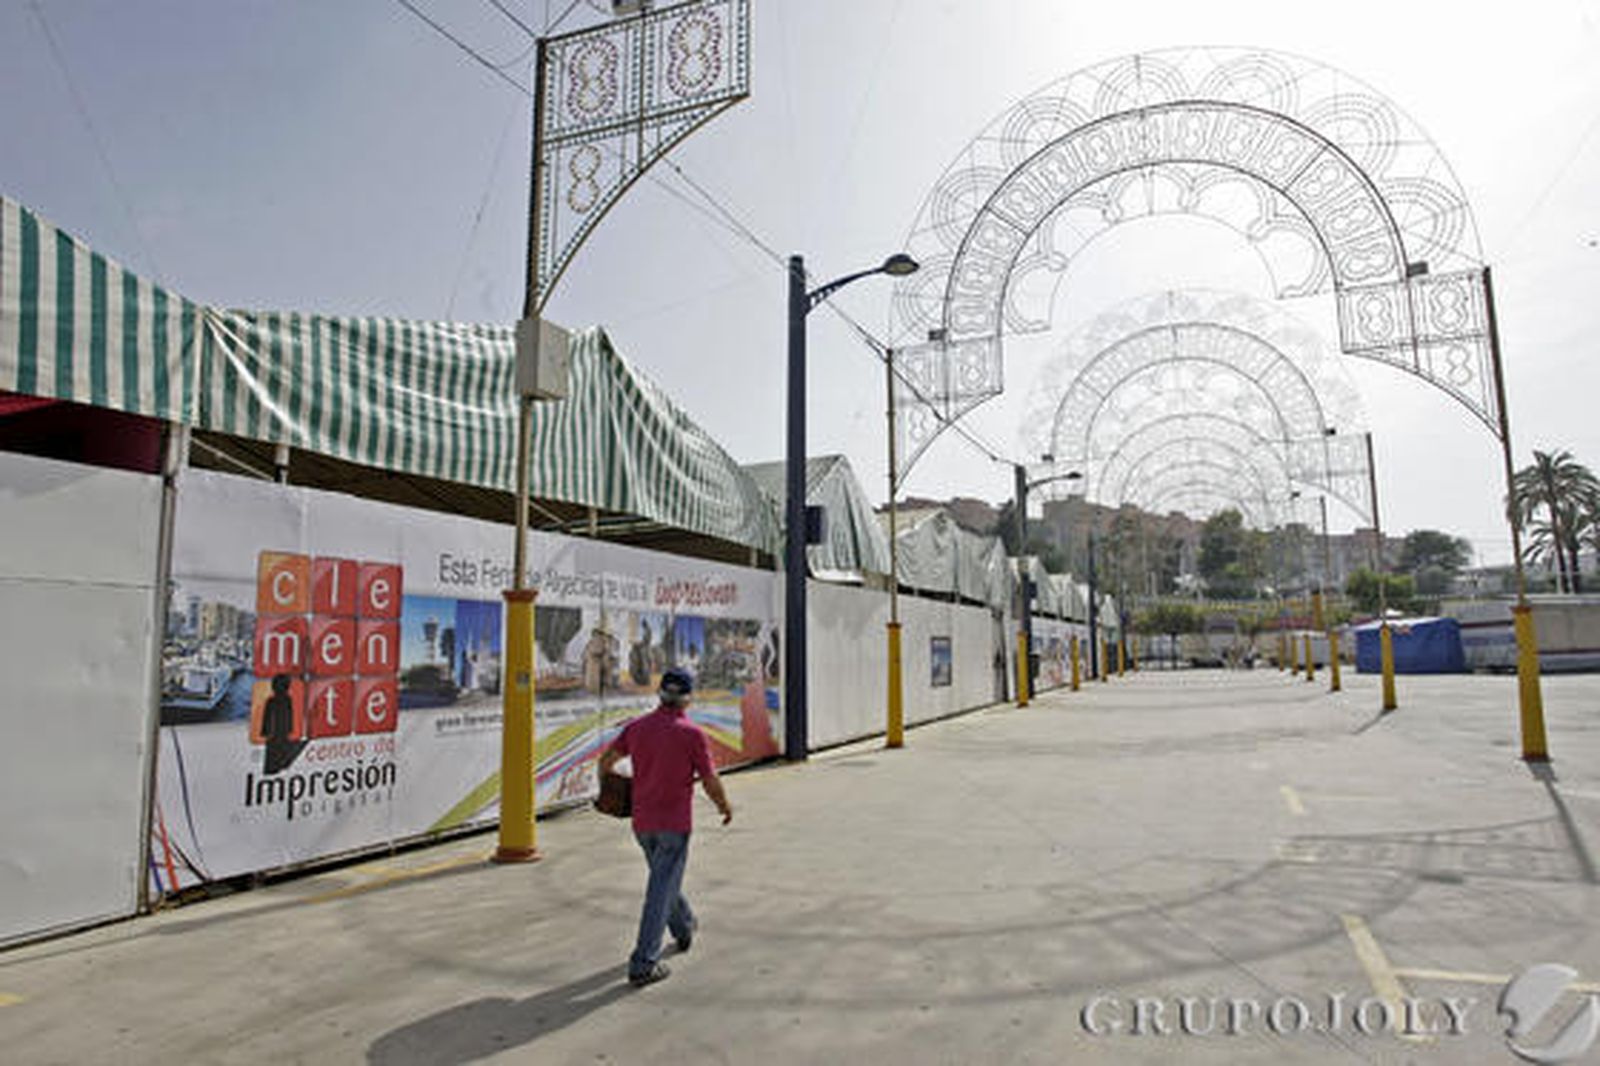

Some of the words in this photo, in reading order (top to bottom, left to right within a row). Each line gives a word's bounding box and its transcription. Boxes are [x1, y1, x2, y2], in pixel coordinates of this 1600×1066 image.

[438, 553, 478, 586] Esta
[305, 740, 366, 763] centro
[244, 756, 397, 821] Impresión
